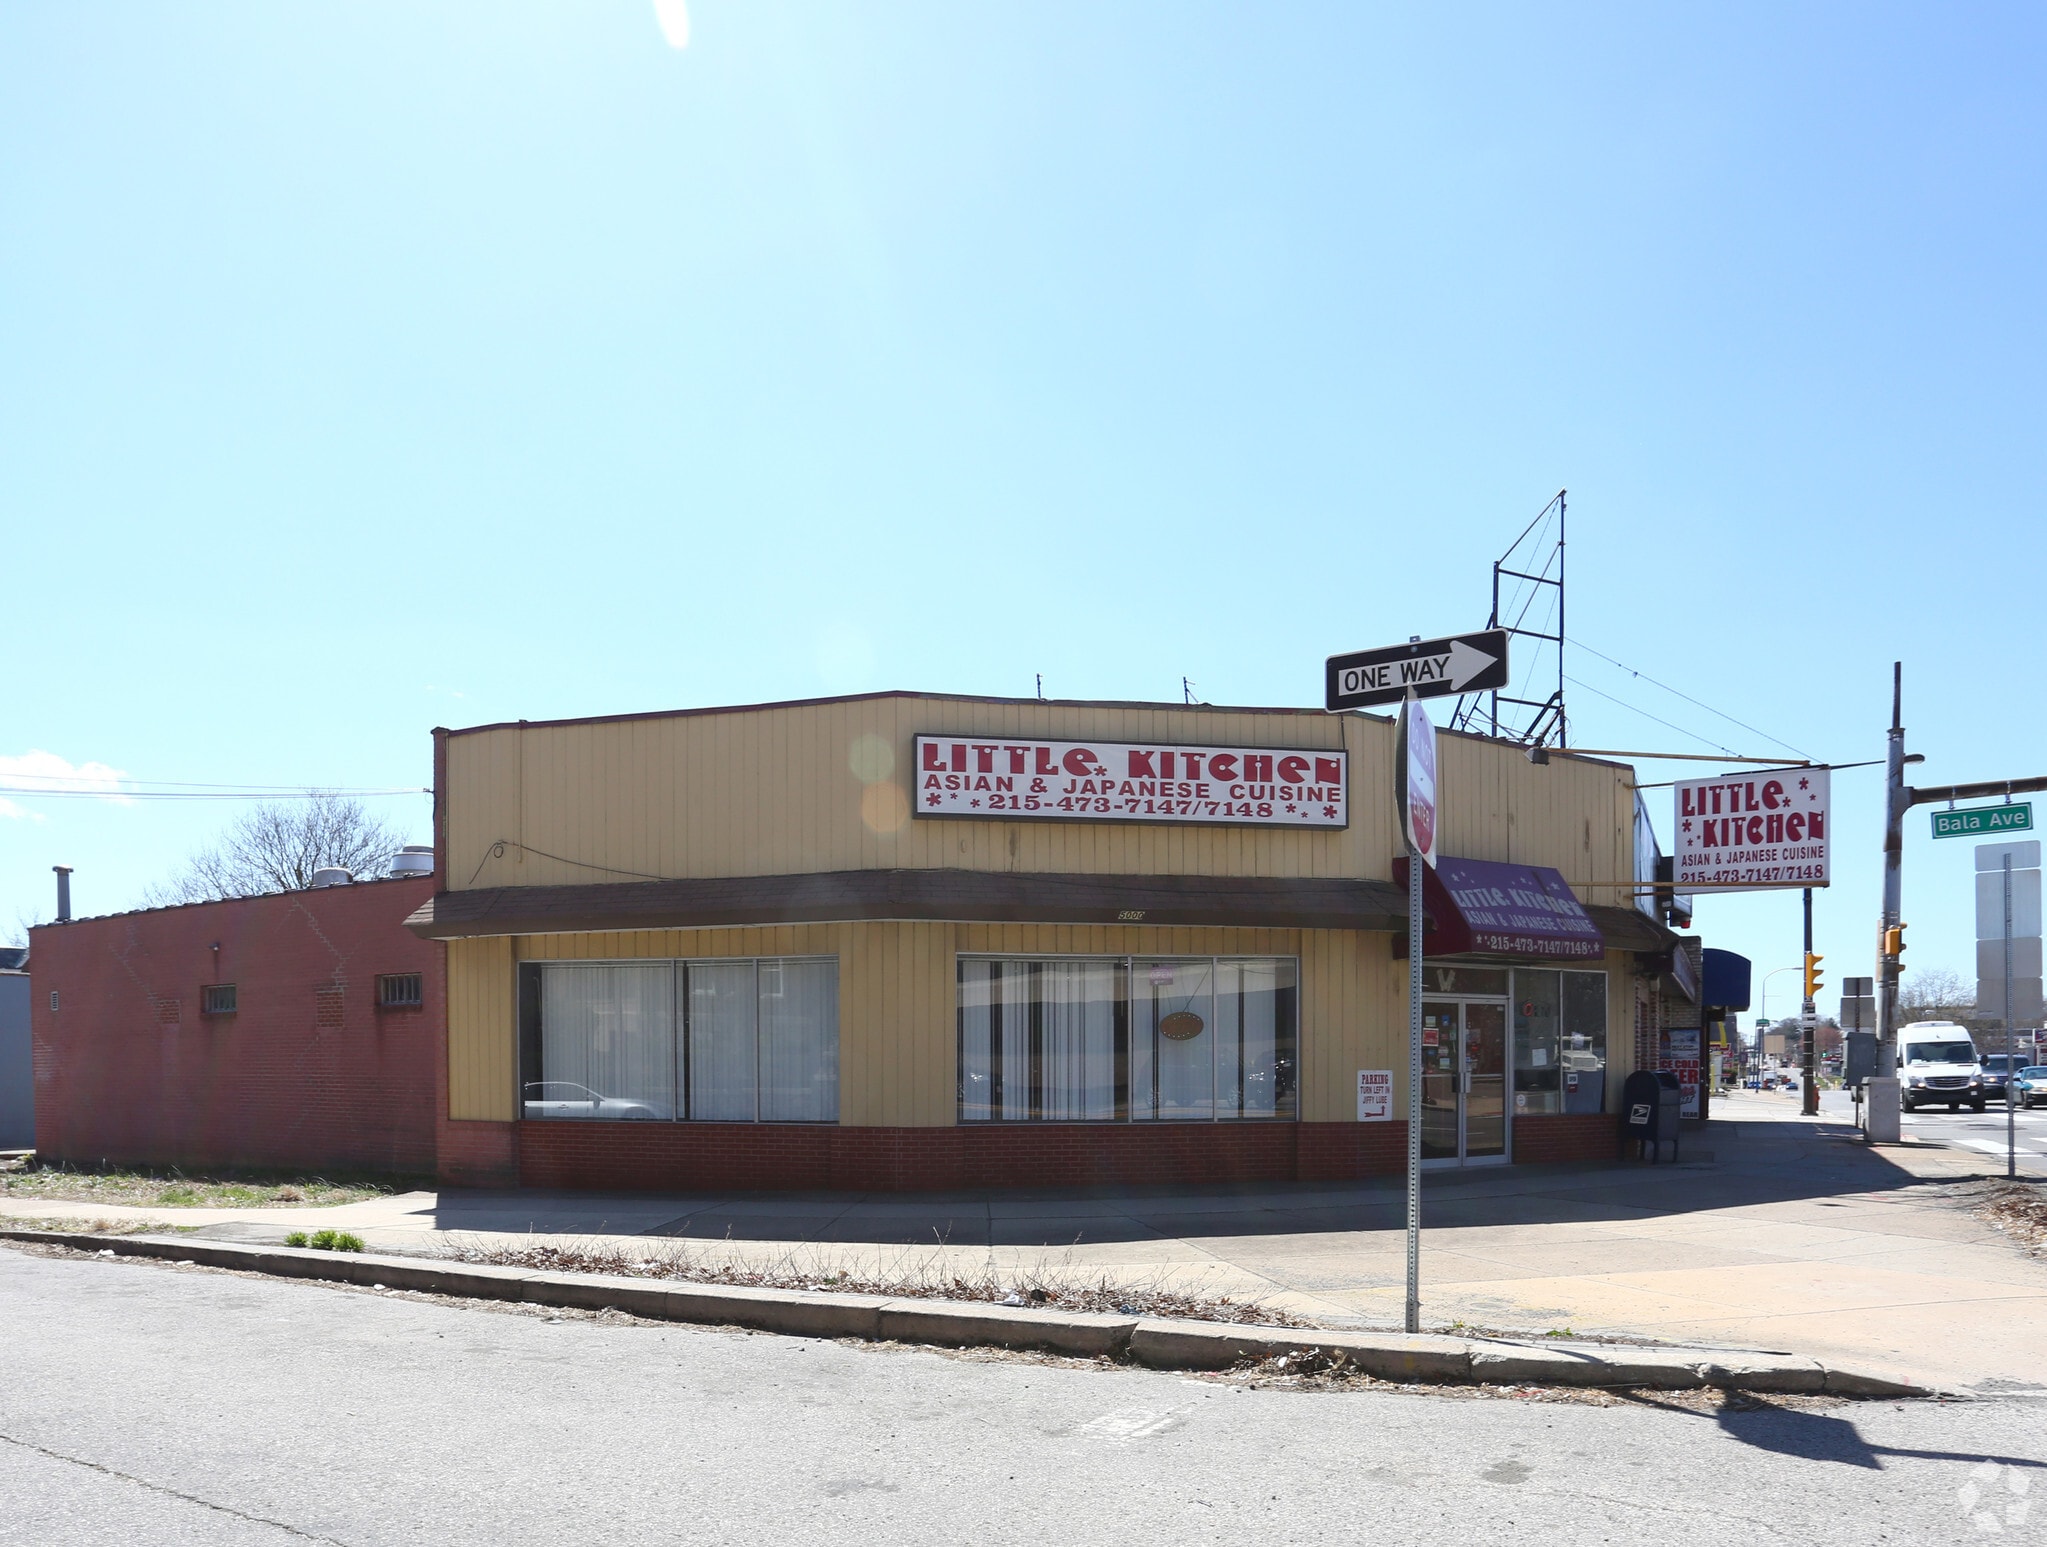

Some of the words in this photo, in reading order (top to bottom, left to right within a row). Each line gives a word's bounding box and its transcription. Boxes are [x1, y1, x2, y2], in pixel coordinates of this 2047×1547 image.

[1344, 666, 1391, 692] ONE
[1400, 656, 1450, 684] WAY
[924, 774, 1013, 792] ASIAN
[1030, 777, 1048, 793] &
[1063, 778, 1210, 799] JAPANESE
[1229, 784, 1341, 802] CUISINE
[988, 794, 1273, 818] 215-473-7147/7148
[1413, 792, 1431, 832] ENTER
[1938, 815, 1980, 832] Bala
[1989, 812, 2025, 827] Ave
[1681, 853, 1710, 867] ASIAN
[1715, 852, 1722, 865] &
[1726, 848, 1777, 864] JAPANESE
[1782, 845, 1824, 860] CUISINE
[1681, 864, 1824, 883] 215-473-7147/7148
[1464, 909, 1498, 926] ASIAN
[1509, 914, 1558, 931] JAPANESE
[1556, 917, 1596, 933] CUISINE
[1490, 935, 1588, 955] 215-473-7147/7148
[1675, 1060, 1698, 1069] COLD
[1362, 1074, 1388, 1084] PARKING
